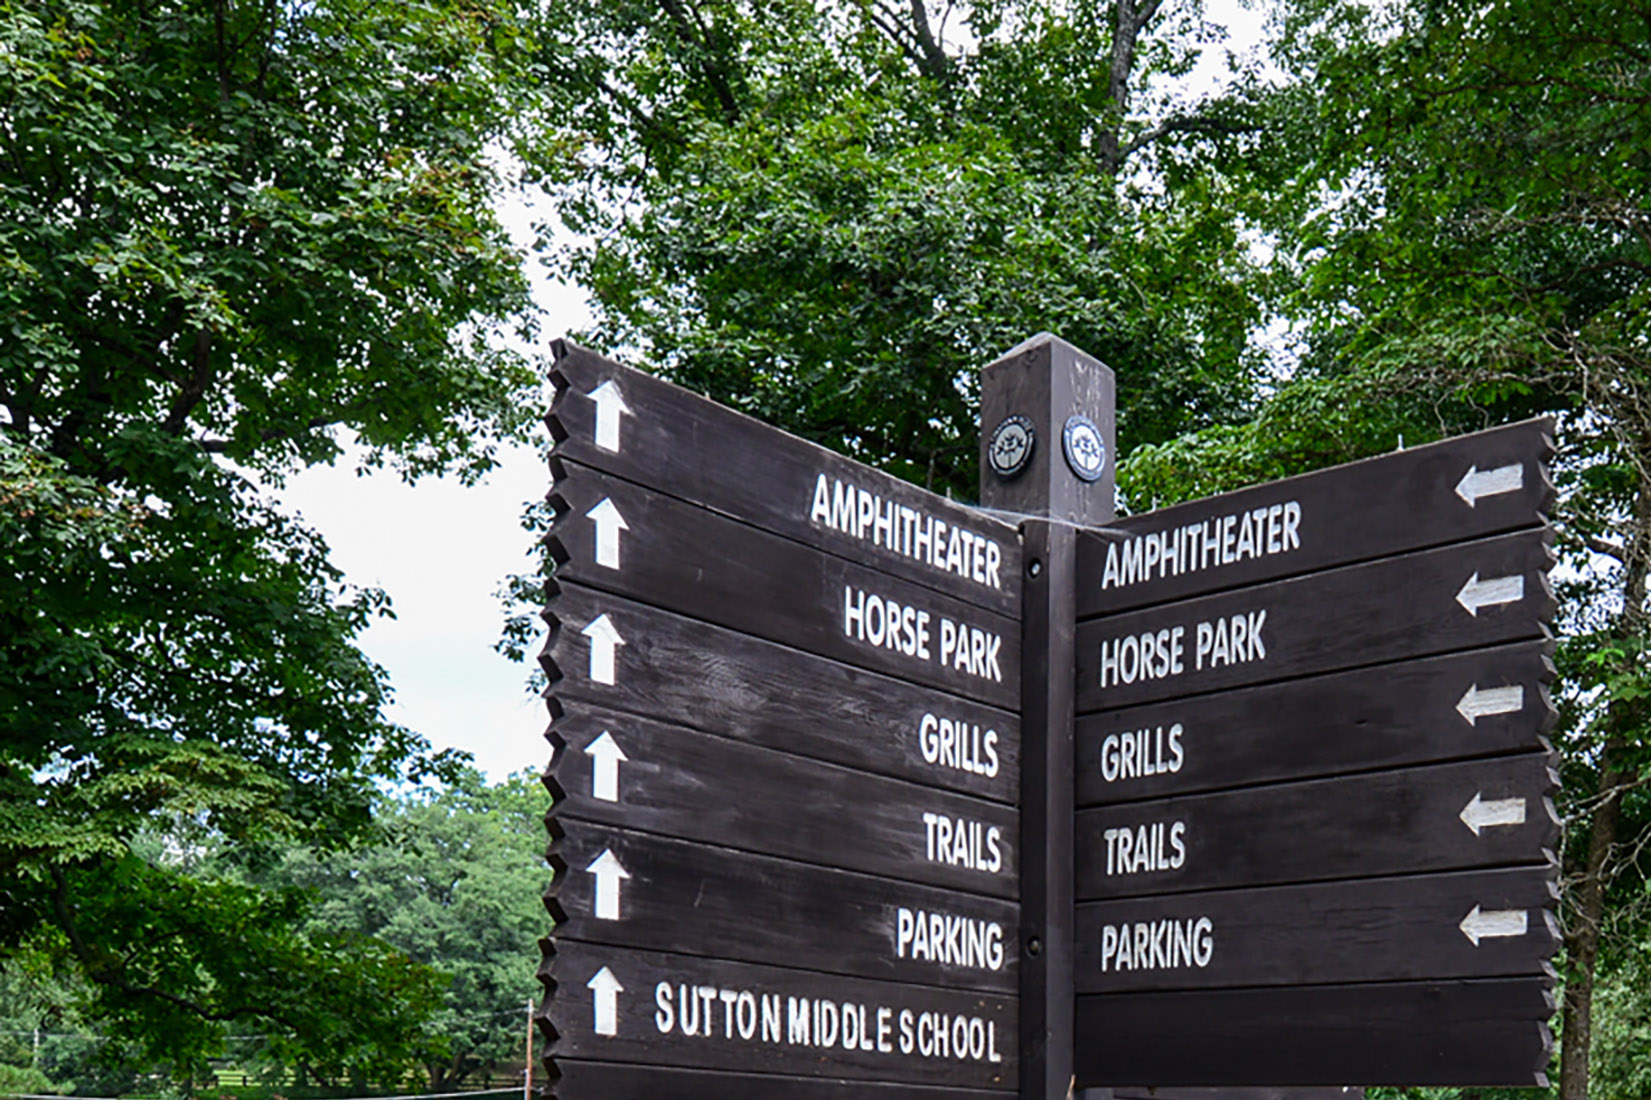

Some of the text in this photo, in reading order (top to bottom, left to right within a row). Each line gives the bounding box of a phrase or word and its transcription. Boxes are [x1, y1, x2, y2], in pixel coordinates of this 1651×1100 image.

[811, 473, 1002, 589] AMPHITHEATER
[1101, 500, 1302, 589] AMPHITHEATER
[845, 586, 1001, 682] HORSE PARK
[1101, 610, 1266, 687] HORSE PARK
[920, 713, 998, 777] GRILLS
[1102, 724, 1183, 781] GRILLS
[923, 812, 1001, 873] TRAILS
[1104, 822, 1185, 875] TRAILS
[898, 908, 1003, 970] PARKING
[1102, 917, 1212, 971] PARKING
[655, 982, 1001, 1062] SUTTON MIDDLE SCHOOL
